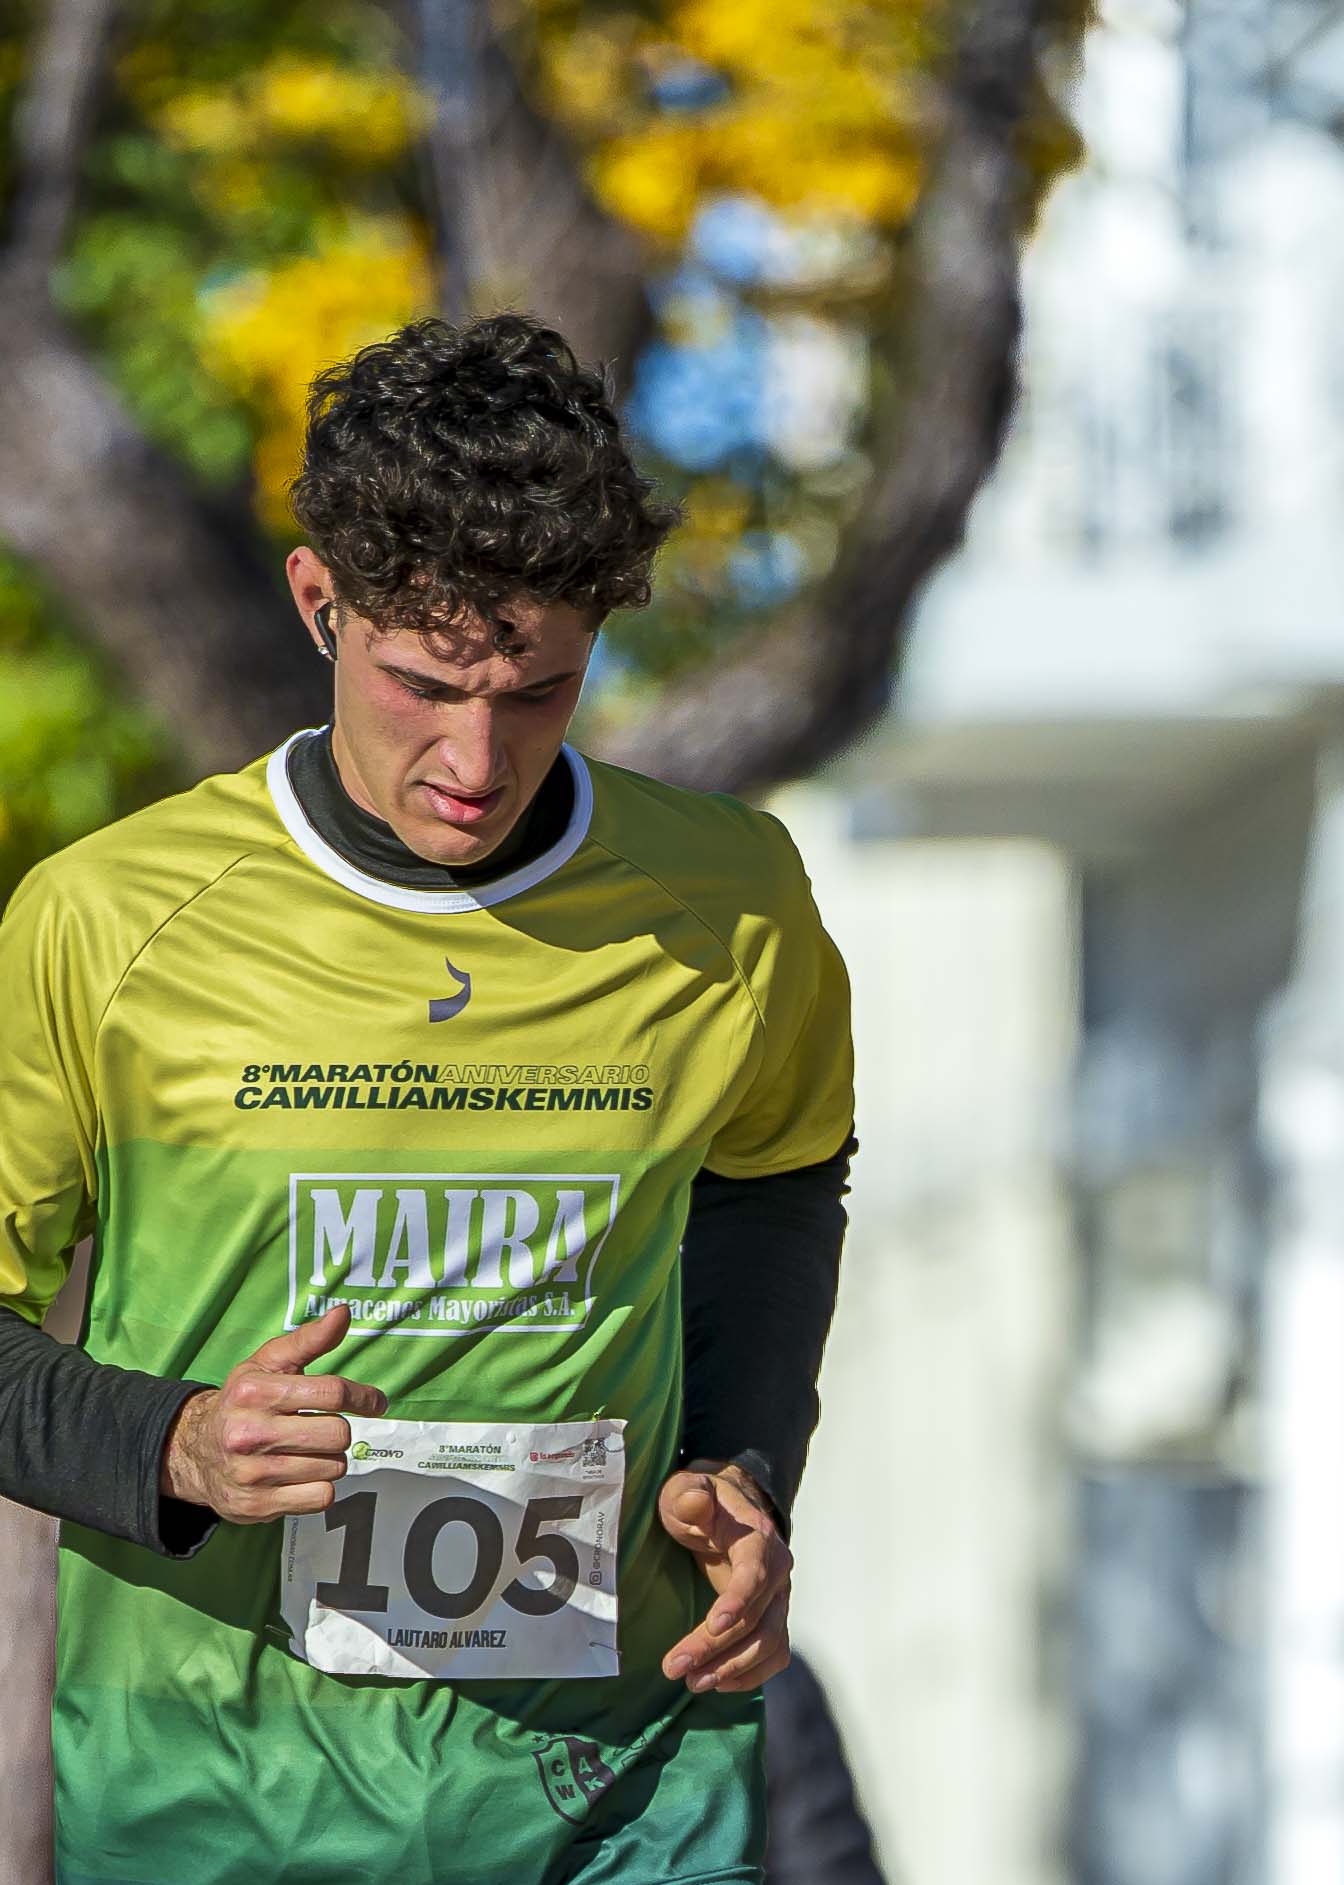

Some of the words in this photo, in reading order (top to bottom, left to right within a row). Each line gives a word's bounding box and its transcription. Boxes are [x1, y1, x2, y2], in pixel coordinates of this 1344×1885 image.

[234, 1086, 655, 1111] CAWILLIAMSKEMMIS
[309, 1188, 588, 1289] MAIRA
[543, 1291, 576, 1317] S.A.
[316, 1491, 585, 1621] 105
[387, 1628, 448, 1649] LAUTARO
[449, 1629, 508, 1649] ALVAREZ
